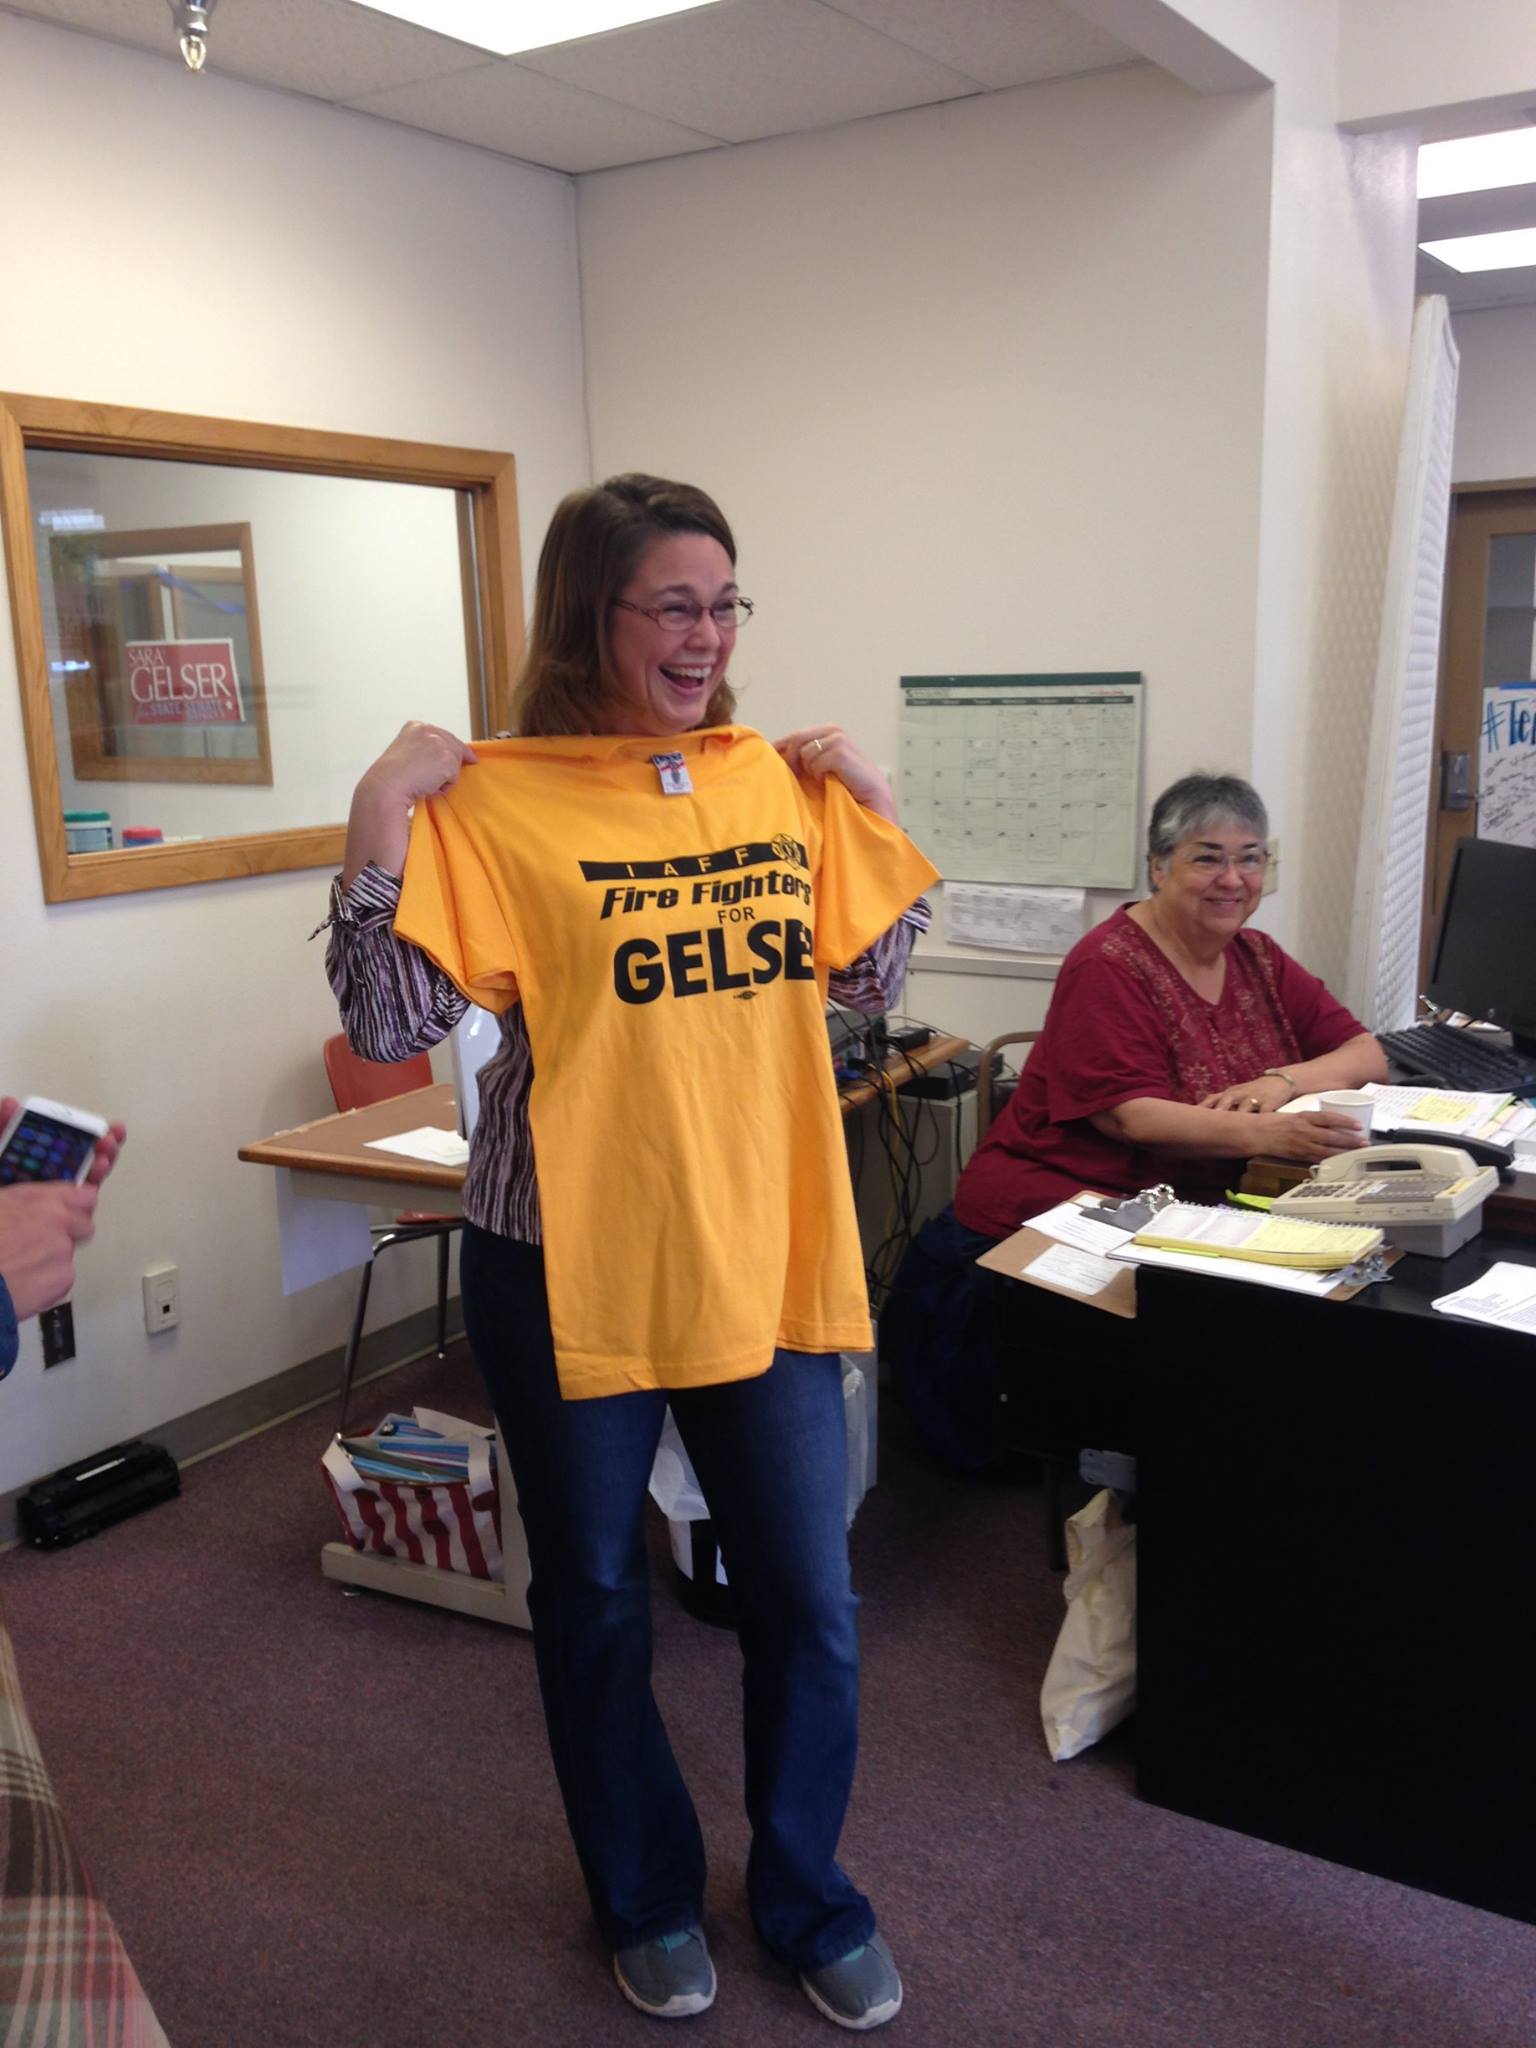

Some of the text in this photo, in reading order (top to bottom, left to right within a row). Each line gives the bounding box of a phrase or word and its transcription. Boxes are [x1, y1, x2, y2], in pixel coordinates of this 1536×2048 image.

[128, 647, 166, 667] SARA
[130, 662, 232, 703] GELSER
[600, 870, 812, 920] Fire Fighters
[717, 906, 756, 924] FOR
